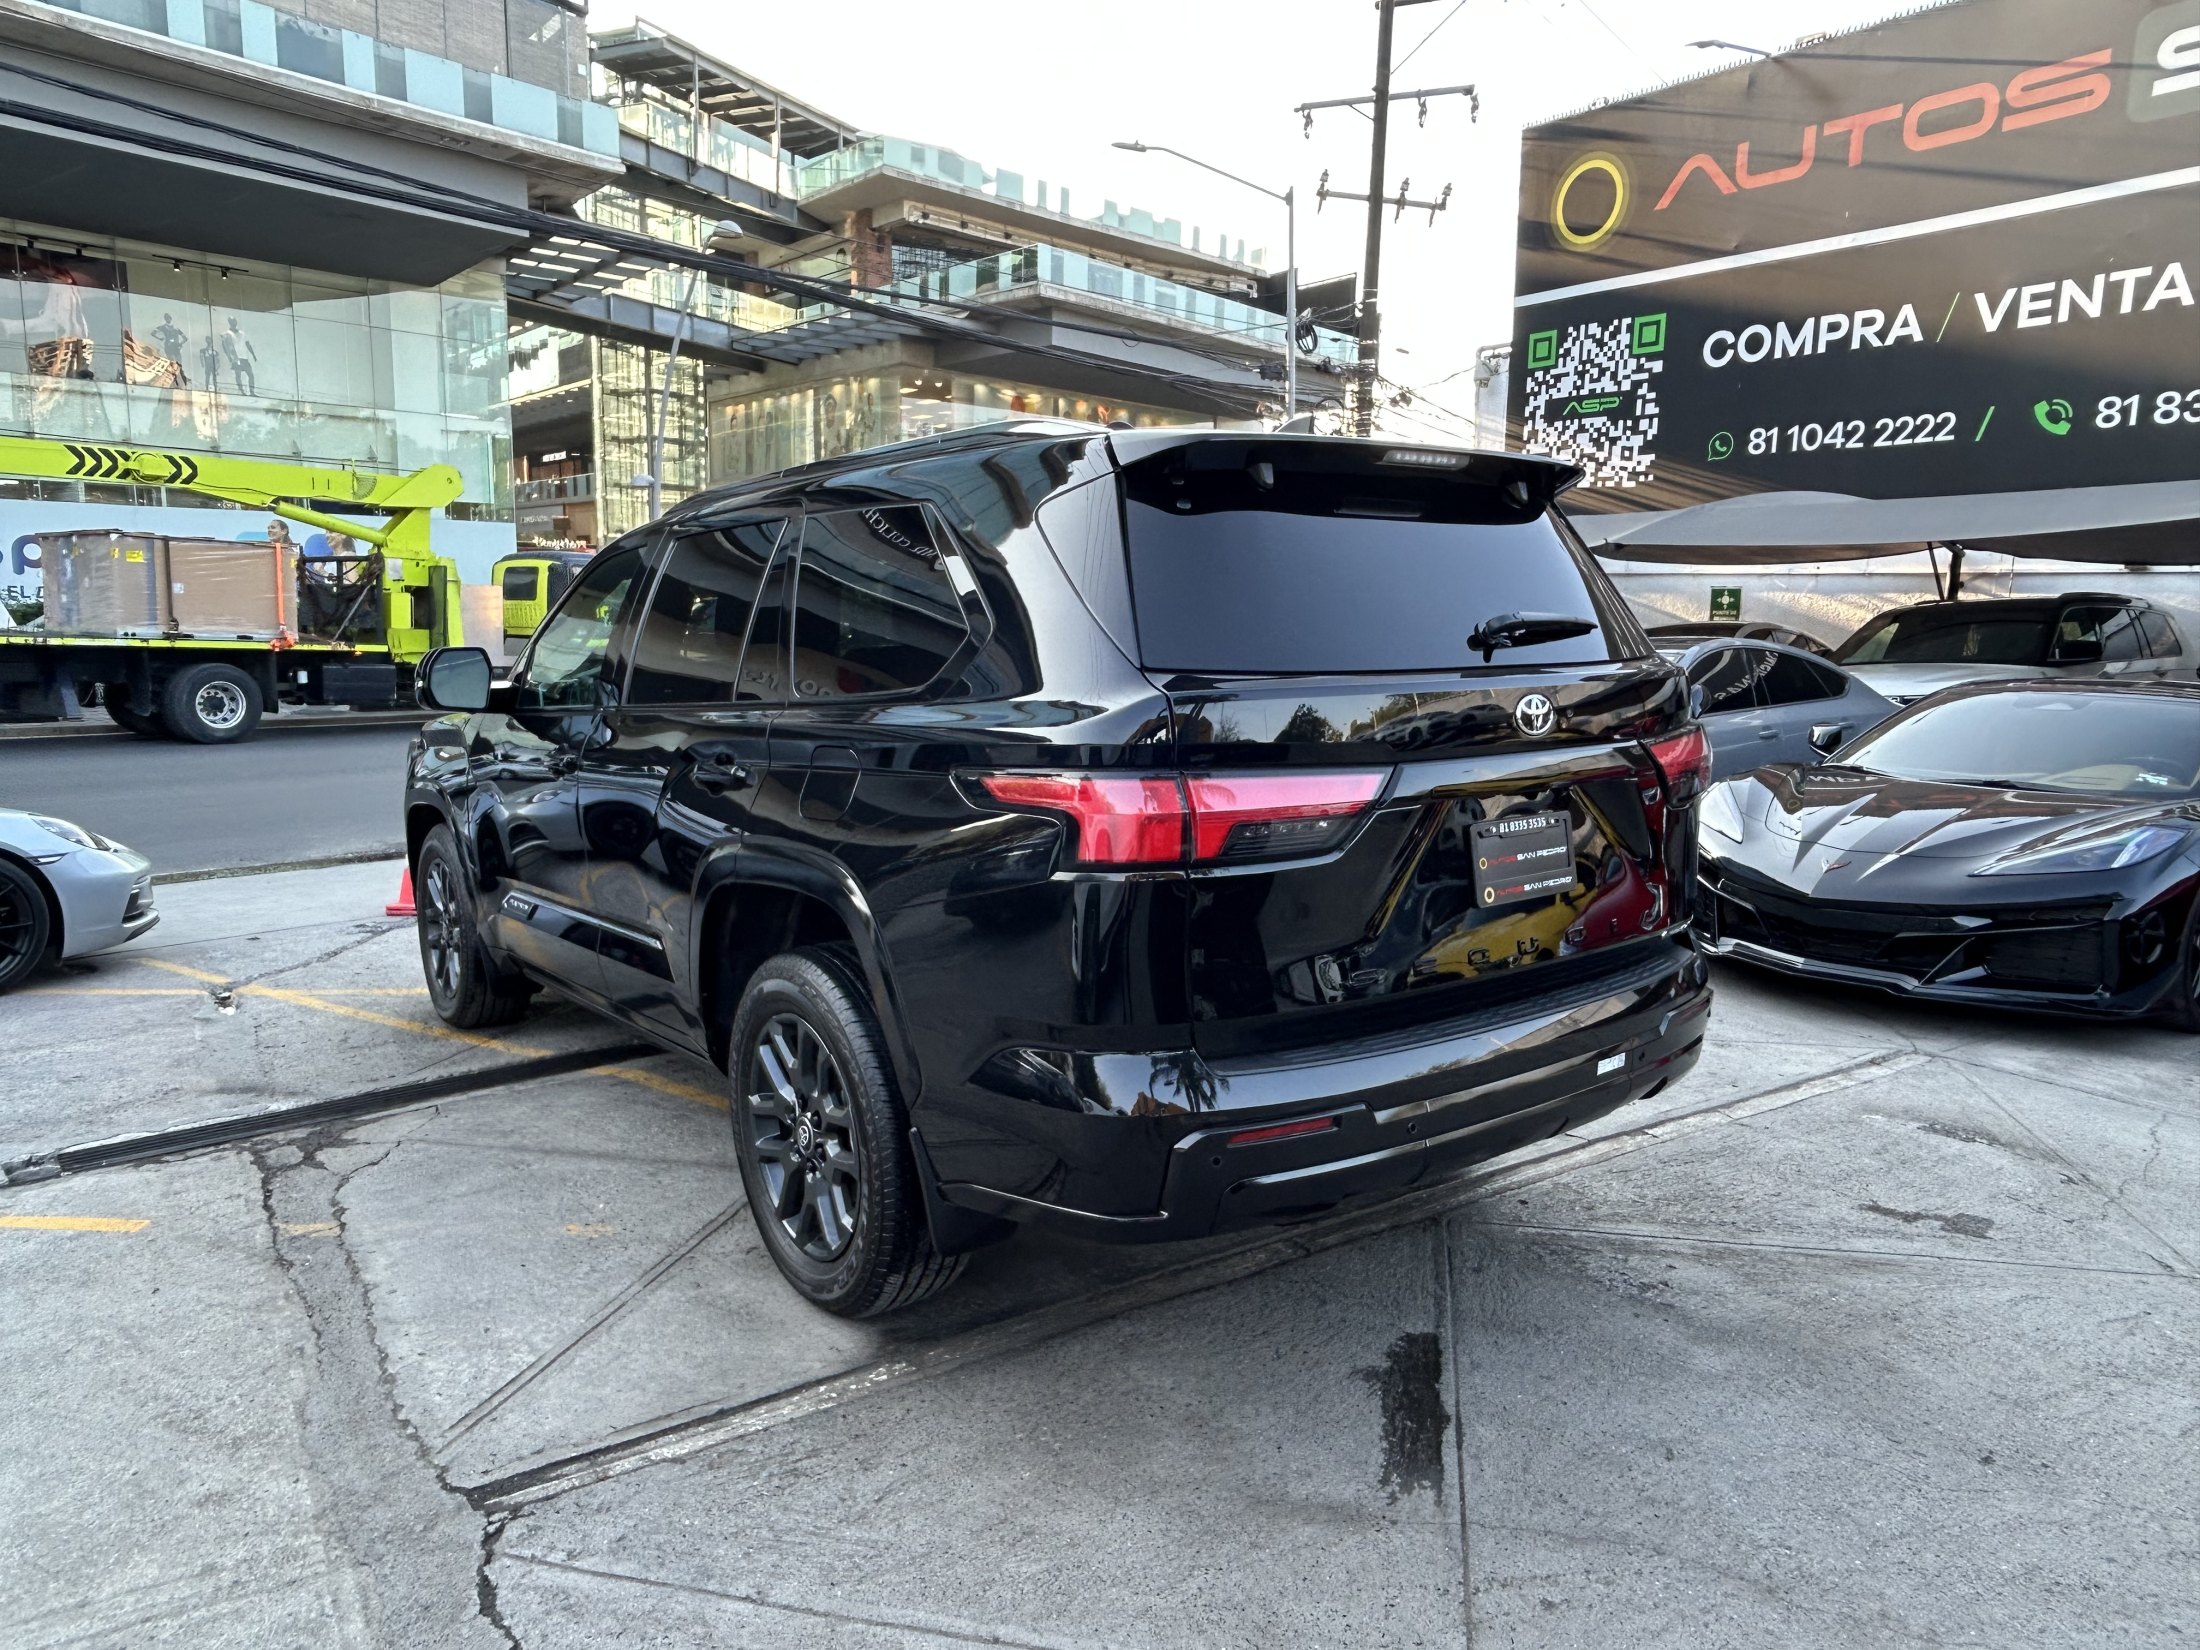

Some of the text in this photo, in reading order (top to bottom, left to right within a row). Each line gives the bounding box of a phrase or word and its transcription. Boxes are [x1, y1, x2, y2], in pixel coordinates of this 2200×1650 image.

[1653, 48, 2112, 211] AUTOS
[1702, 303, 1924, 368] COMPRA
[1974, 261, 2196, 333] VENTA
[1563, 397, 1619, 415] ASP
[1748, 427, 1779, 455] 81
[1787, 420, 1866, 452] 1042
[1873, 411, 1957, 447] 2222
[2095, 394, 2140, 429] 81
